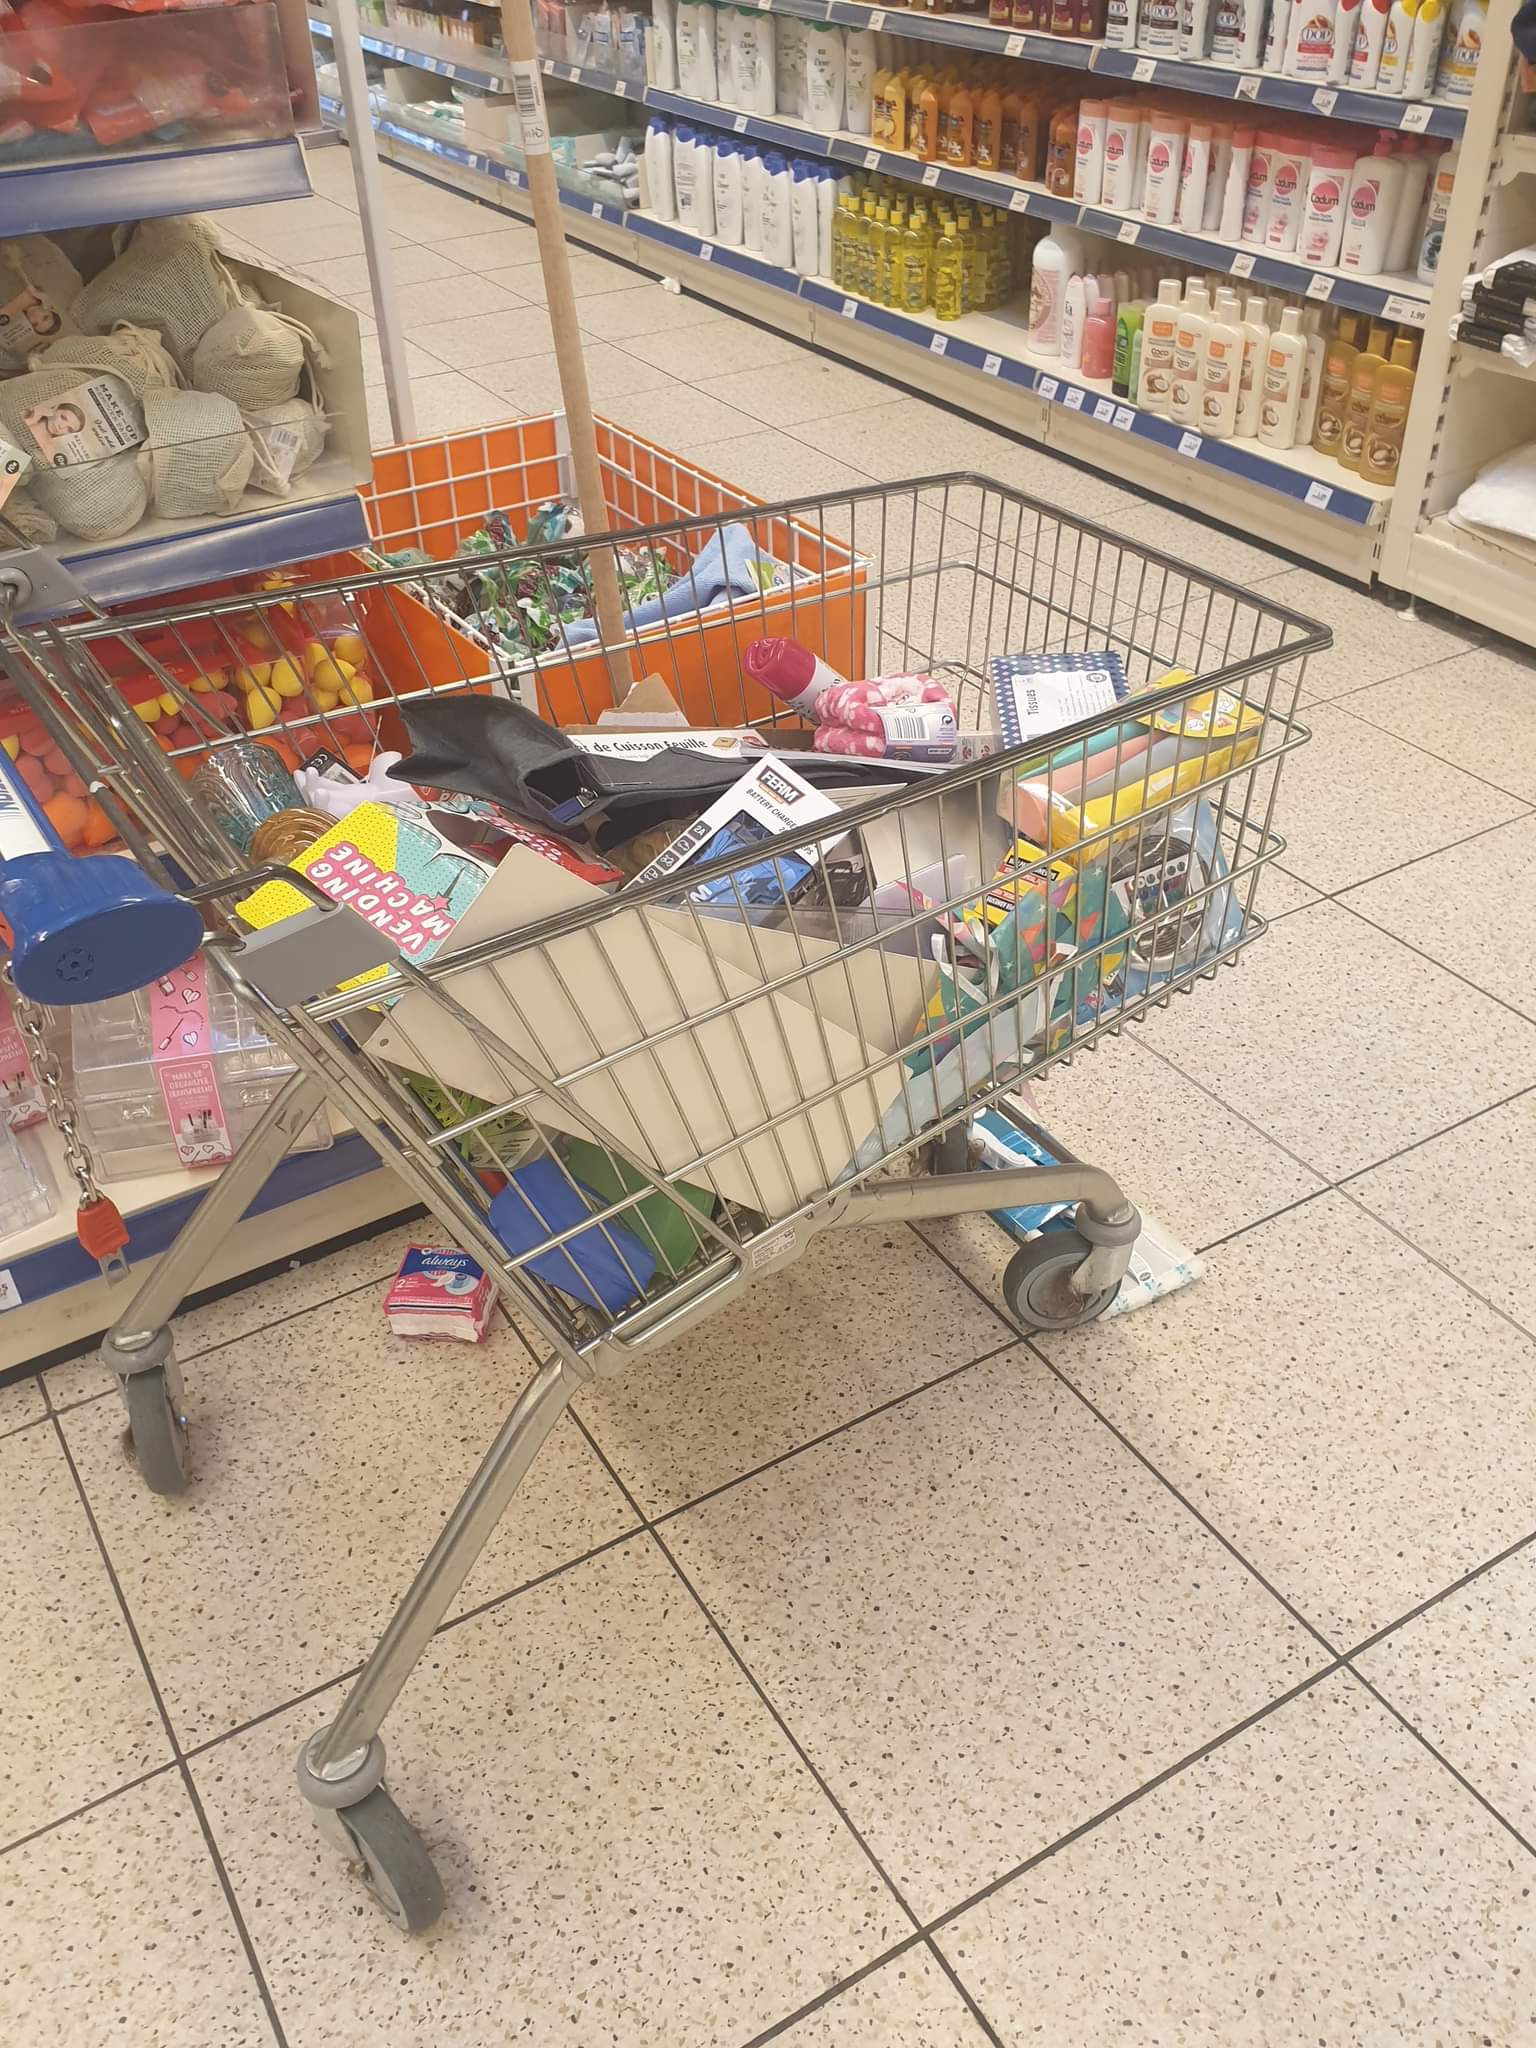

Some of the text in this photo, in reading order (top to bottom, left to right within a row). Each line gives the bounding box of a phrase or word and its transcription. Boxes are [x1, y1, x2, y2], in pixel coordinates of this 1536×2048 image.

[1304, 28, 1331, 42] DOP
[1311, 192, 1339, 206] Cadum
[1351, 198, 1376, 212] Cadum
[100, 383, 138, 440] MAKE-UP
[1026, 689, 1039, 716] Tissues
[593, 742, 611, 752] de
[613, 739, 664, 752] Cuisson
[664, 738, 708, 751] Feuille
[760, 770, 800, 804] FERM
[746, 788, 797, 829] BATTERY CHARGE
[328, 845, 451, 938] MACHINE
[310, 863, 423, 951] VENDING
[421, 1255, 469, 1270] always
